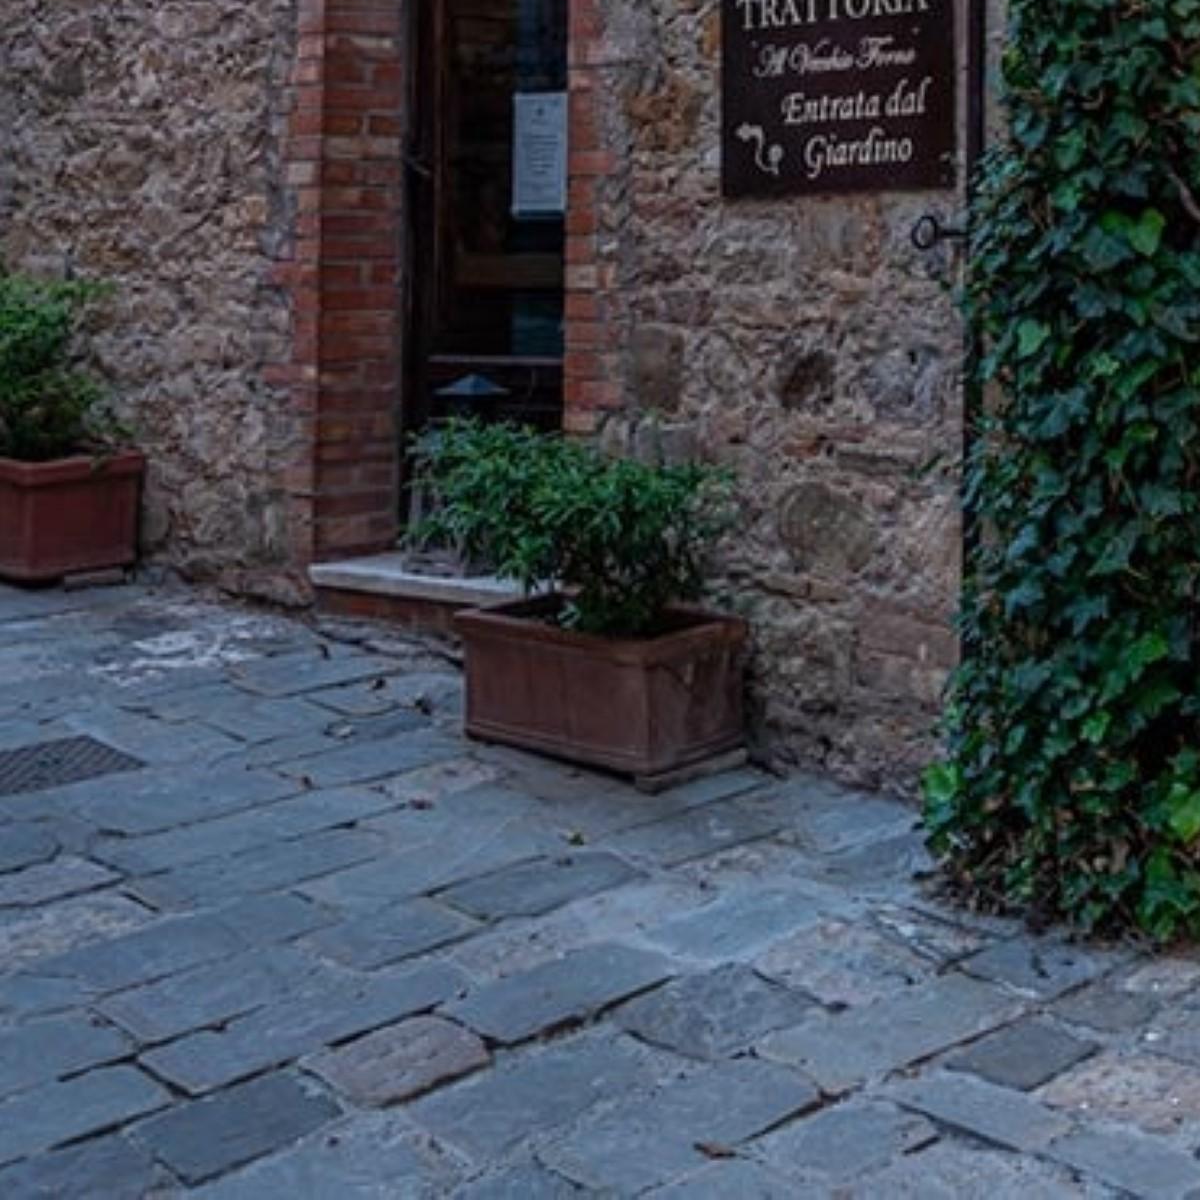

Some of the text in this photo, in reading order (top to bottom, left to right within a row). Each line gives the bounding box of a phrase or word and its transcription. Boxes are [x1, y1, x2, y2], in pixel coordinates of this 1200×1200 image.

[781, 76, 933, 124] Entrata dal
[803, 127, 914, 179] Giardino
